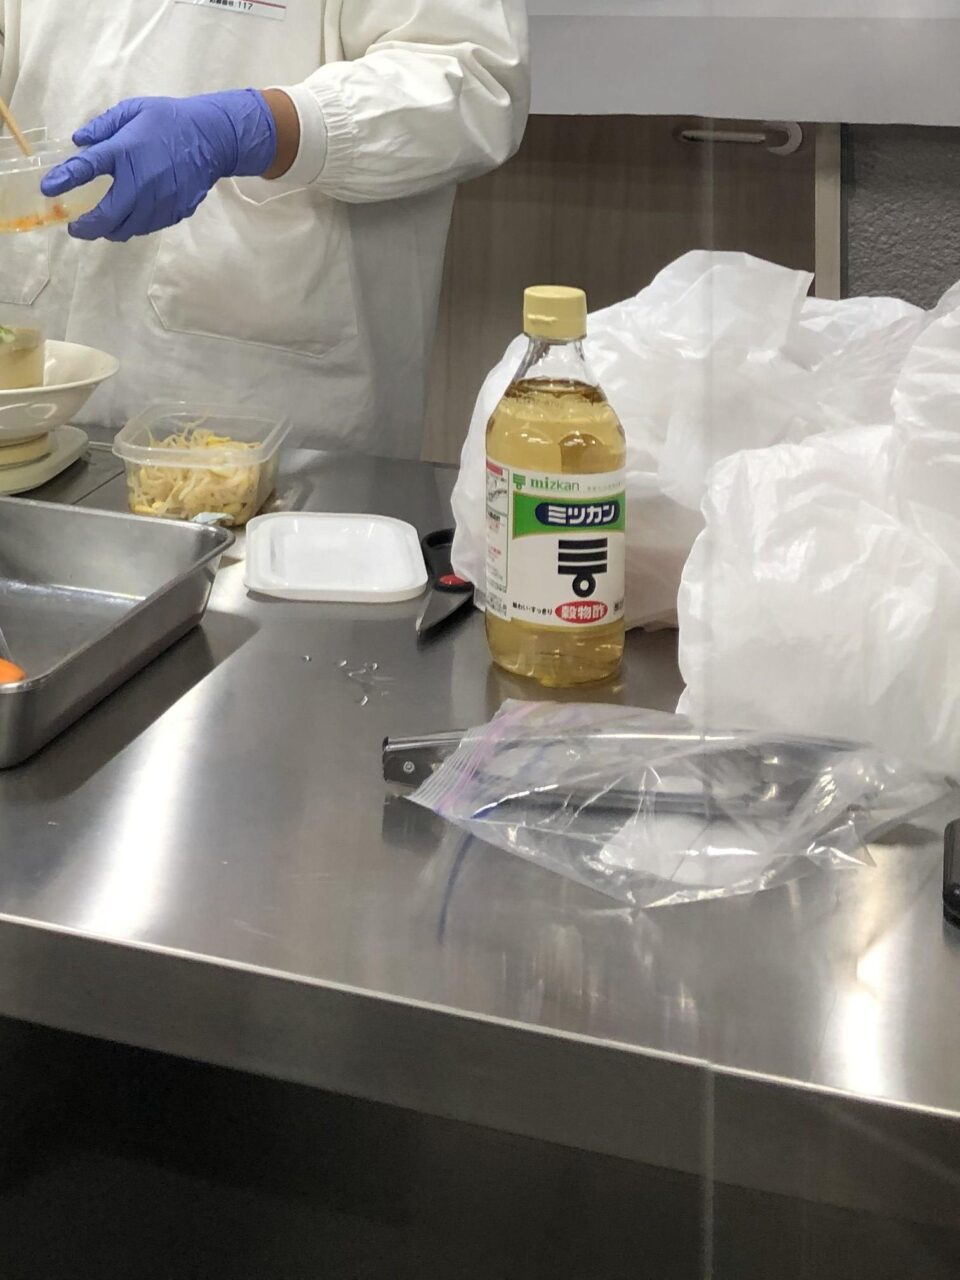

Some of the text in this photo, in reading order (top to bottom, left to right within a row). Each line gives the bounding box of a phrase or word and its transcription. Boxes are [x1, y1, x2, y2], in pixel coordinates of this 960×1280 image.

[530, 476, 580, 492] mizkan
[548, 503, 616, 525] ミツカン
[560, 604, 606, 621] 穀物酢
